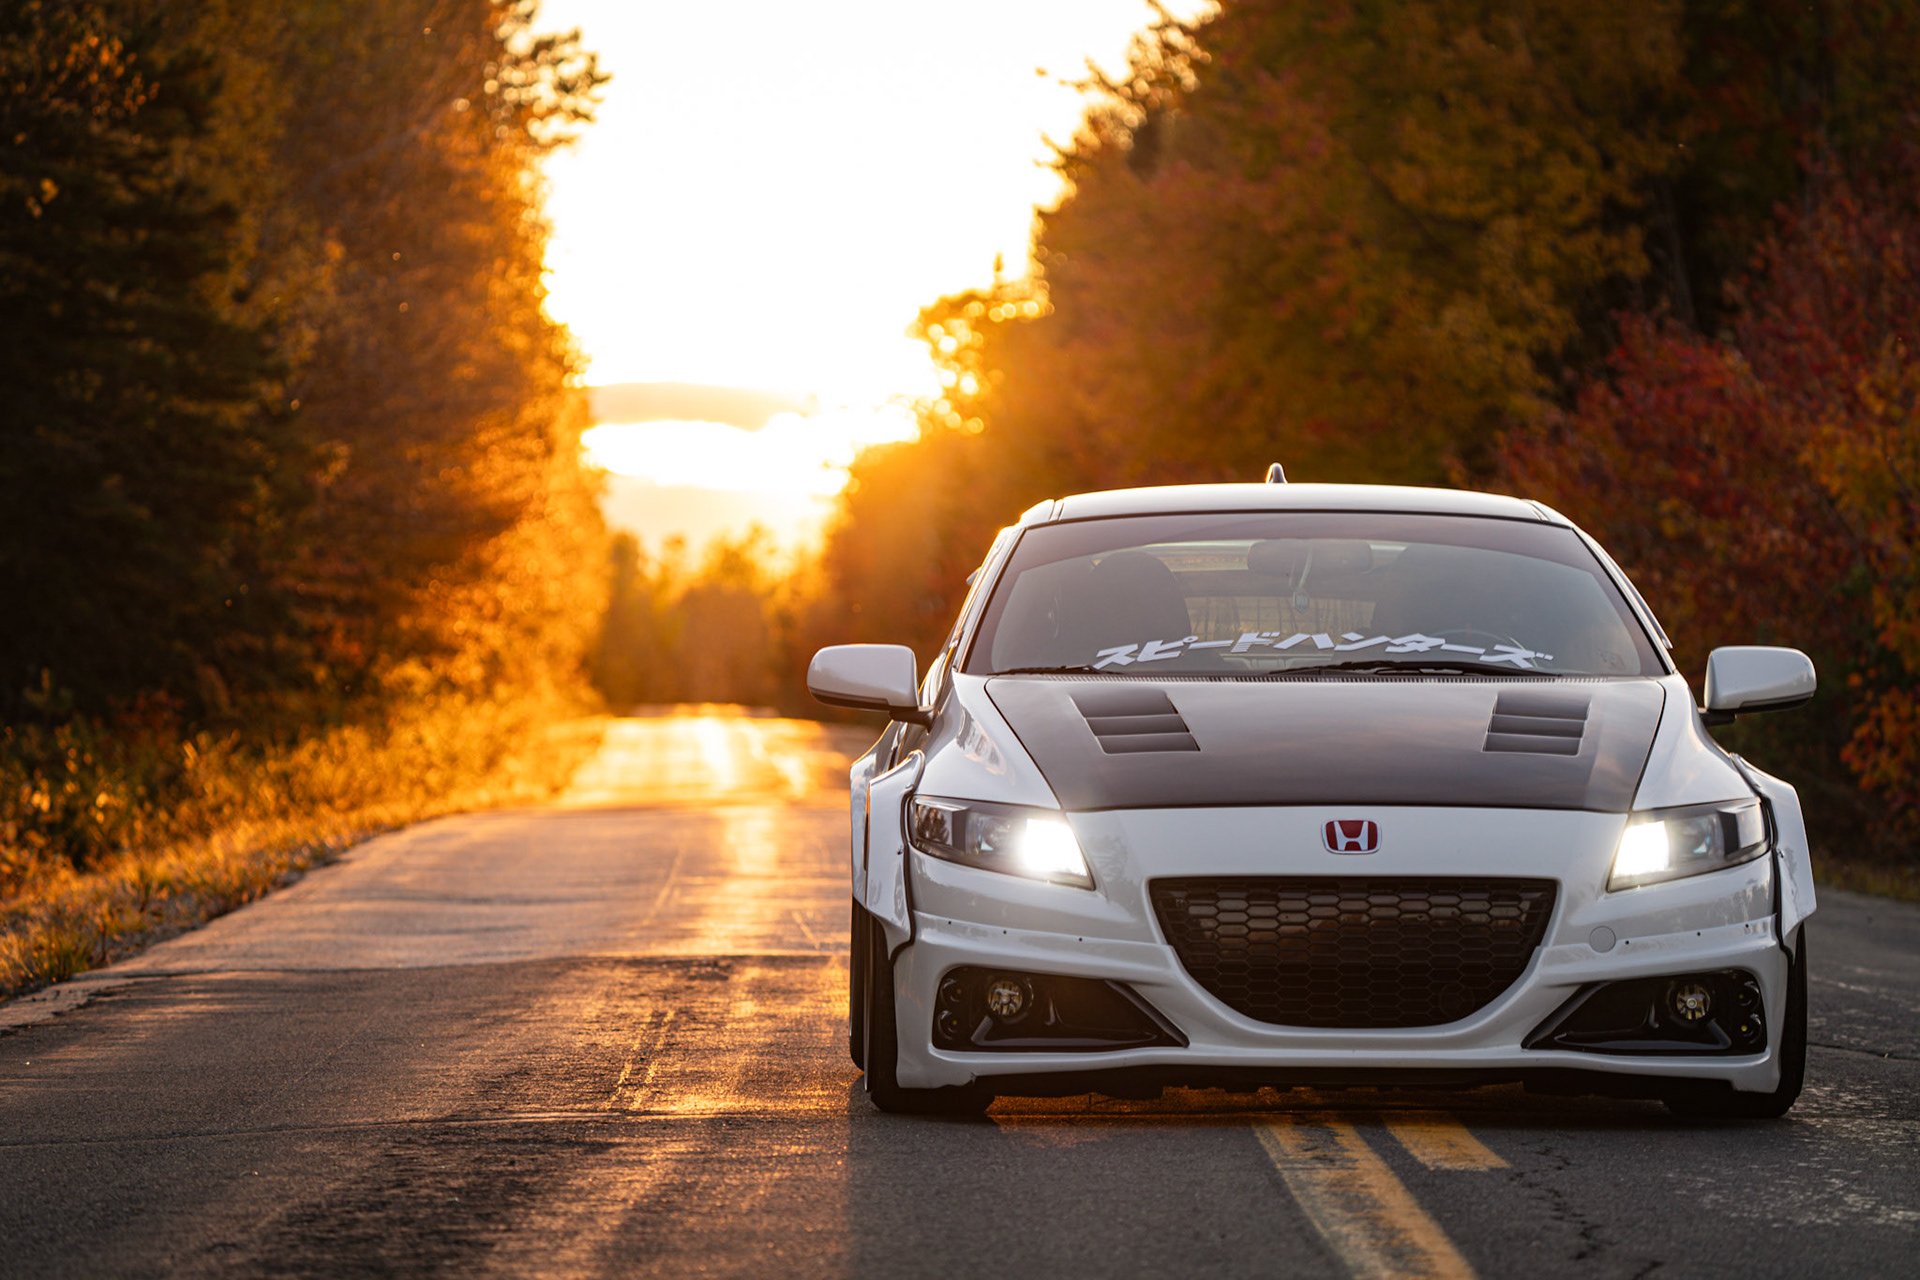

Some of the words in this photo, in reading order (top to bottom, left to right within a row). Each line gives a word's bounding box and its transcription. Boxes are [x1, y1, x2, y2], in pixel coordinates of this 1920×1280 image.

[1092, 632, 1554, 670] スピードハンターズ
